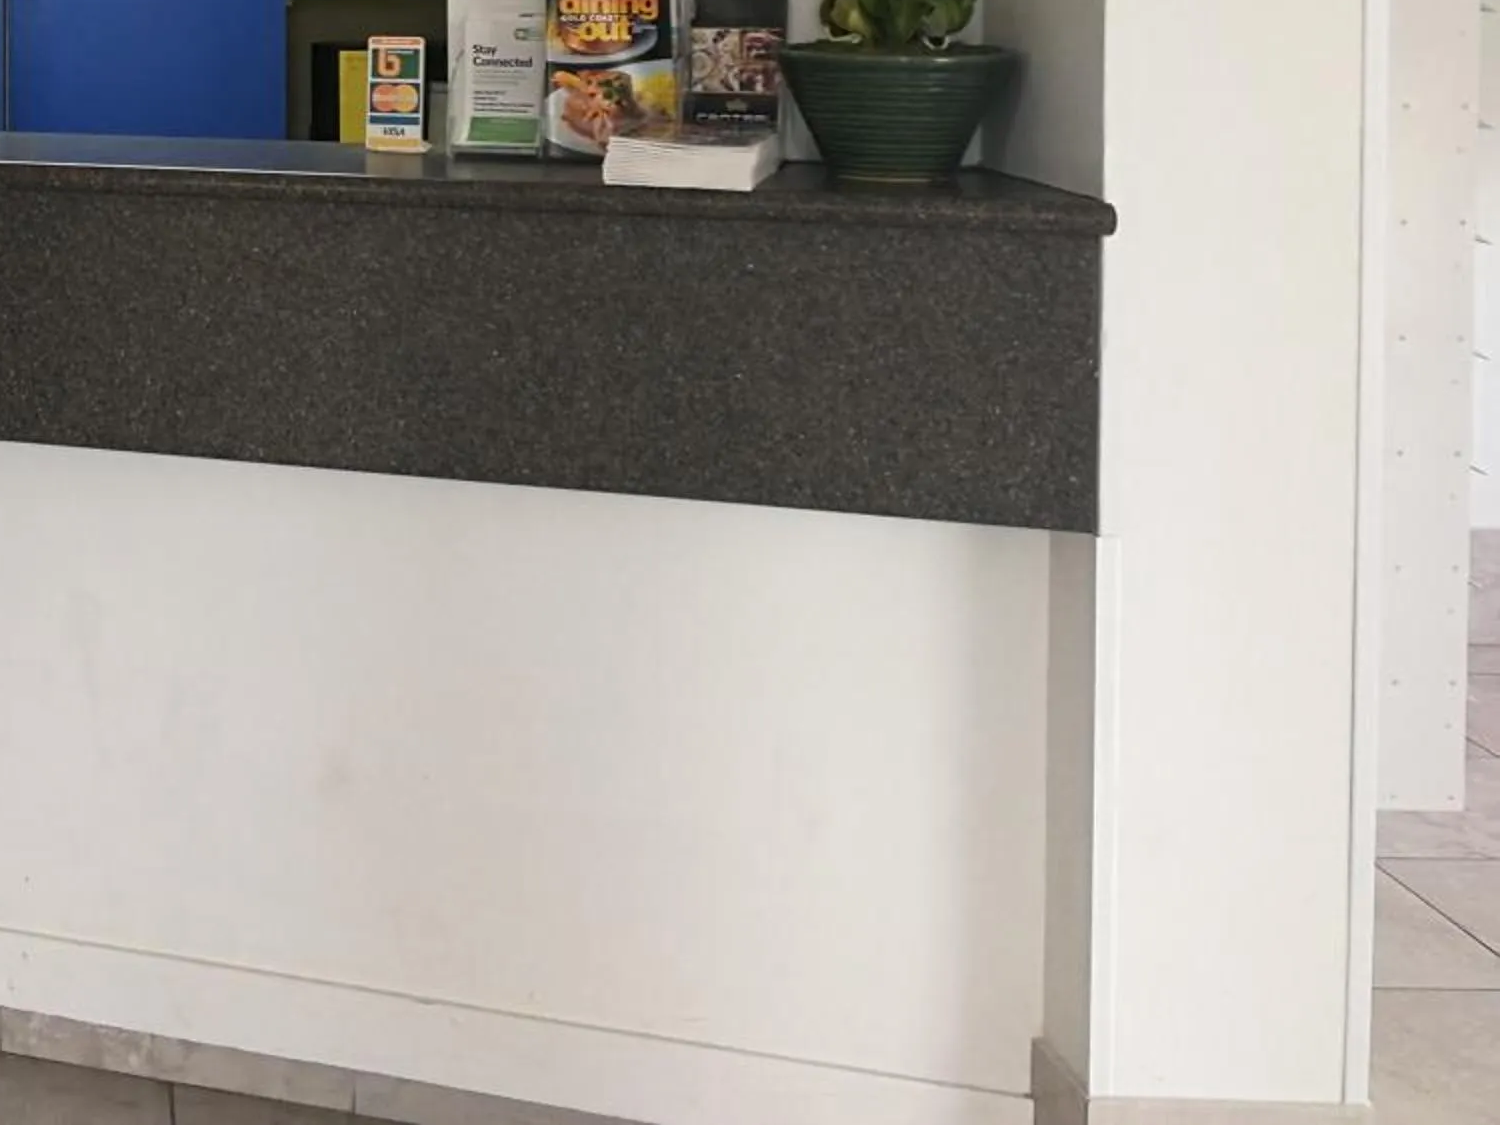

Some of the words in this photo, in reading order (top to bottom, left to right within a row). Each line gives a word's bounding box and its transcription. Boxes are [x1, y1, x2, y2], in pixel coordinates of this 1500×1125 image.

[579, 14, 633, 42] out
[472, 44, 497, 57] Stay
[473, 56, 533, 67] Connected
